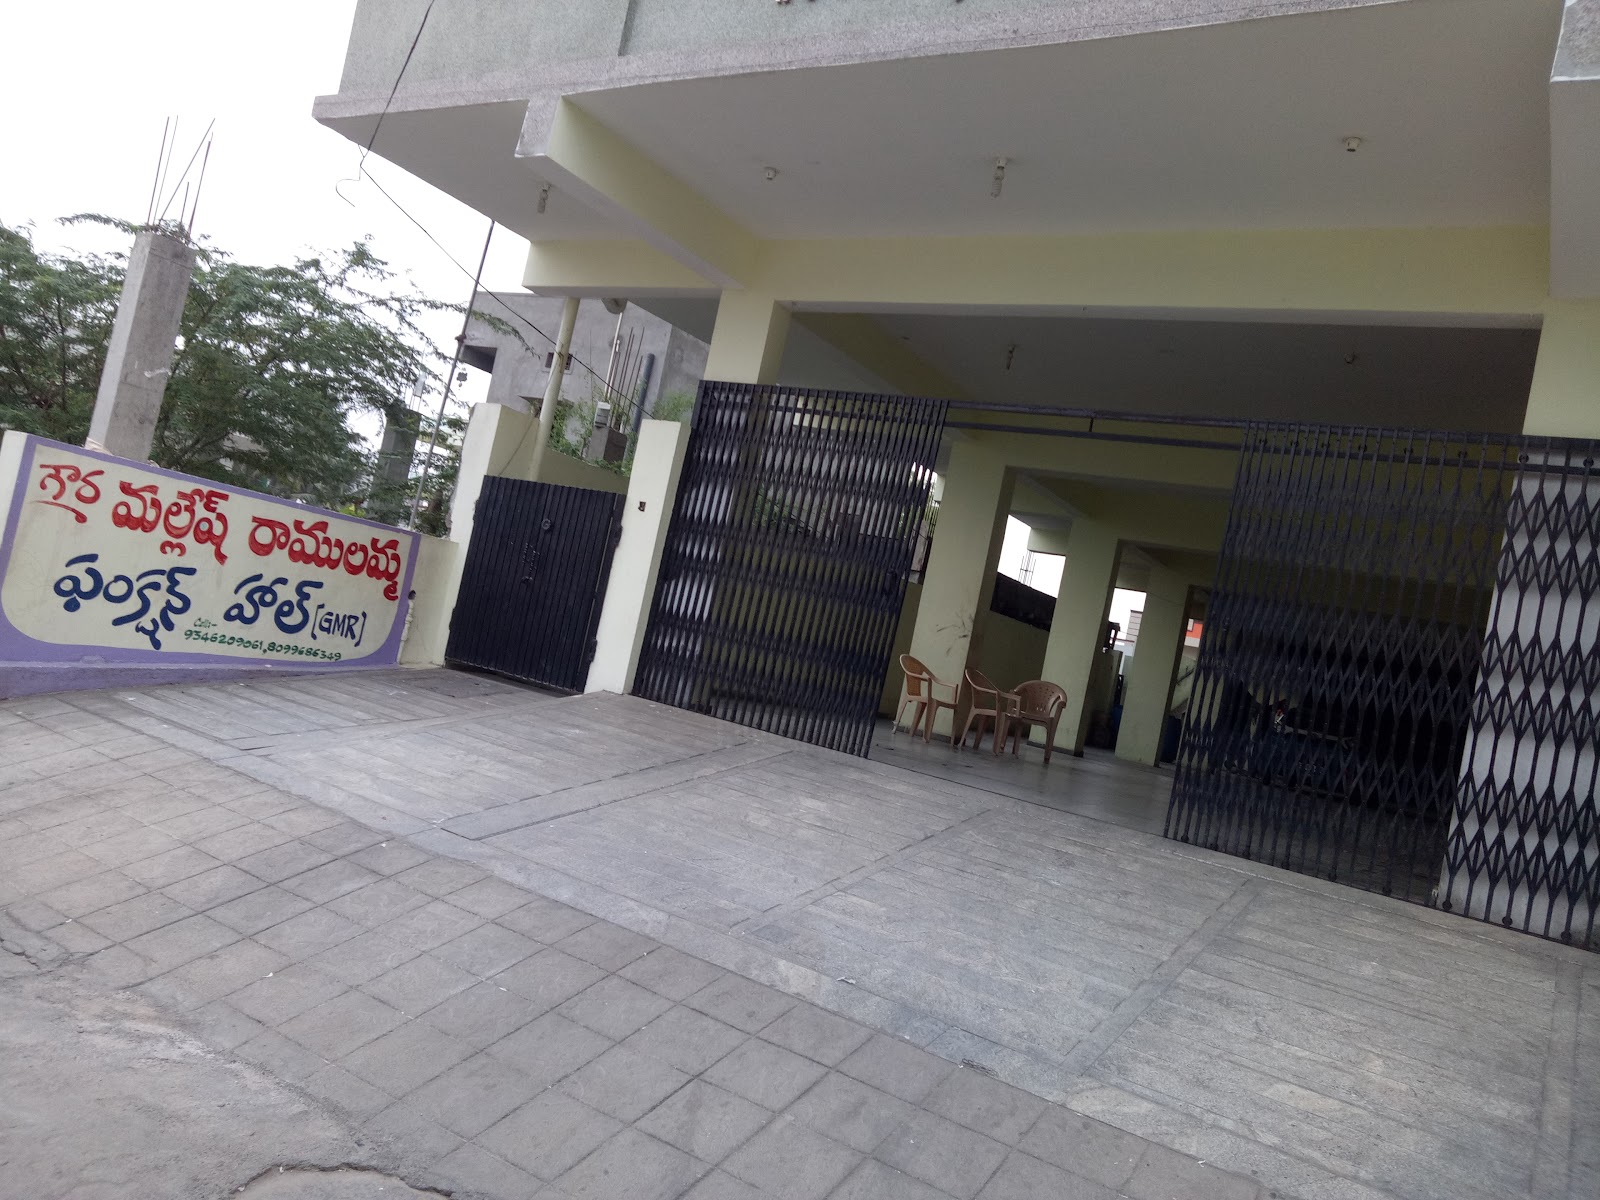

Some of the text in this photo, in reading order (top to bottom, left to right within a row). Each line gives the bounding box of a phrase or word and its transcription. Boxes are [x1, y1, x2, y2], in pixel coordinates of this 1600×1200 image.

[111, 480, 230, 566] మల్లేష్
[248, 515, 401, 601] రాములమ్మ
[53, 553, 197, 651] ఫంక్షన్
[223, 573, 324, 635] హాల్
